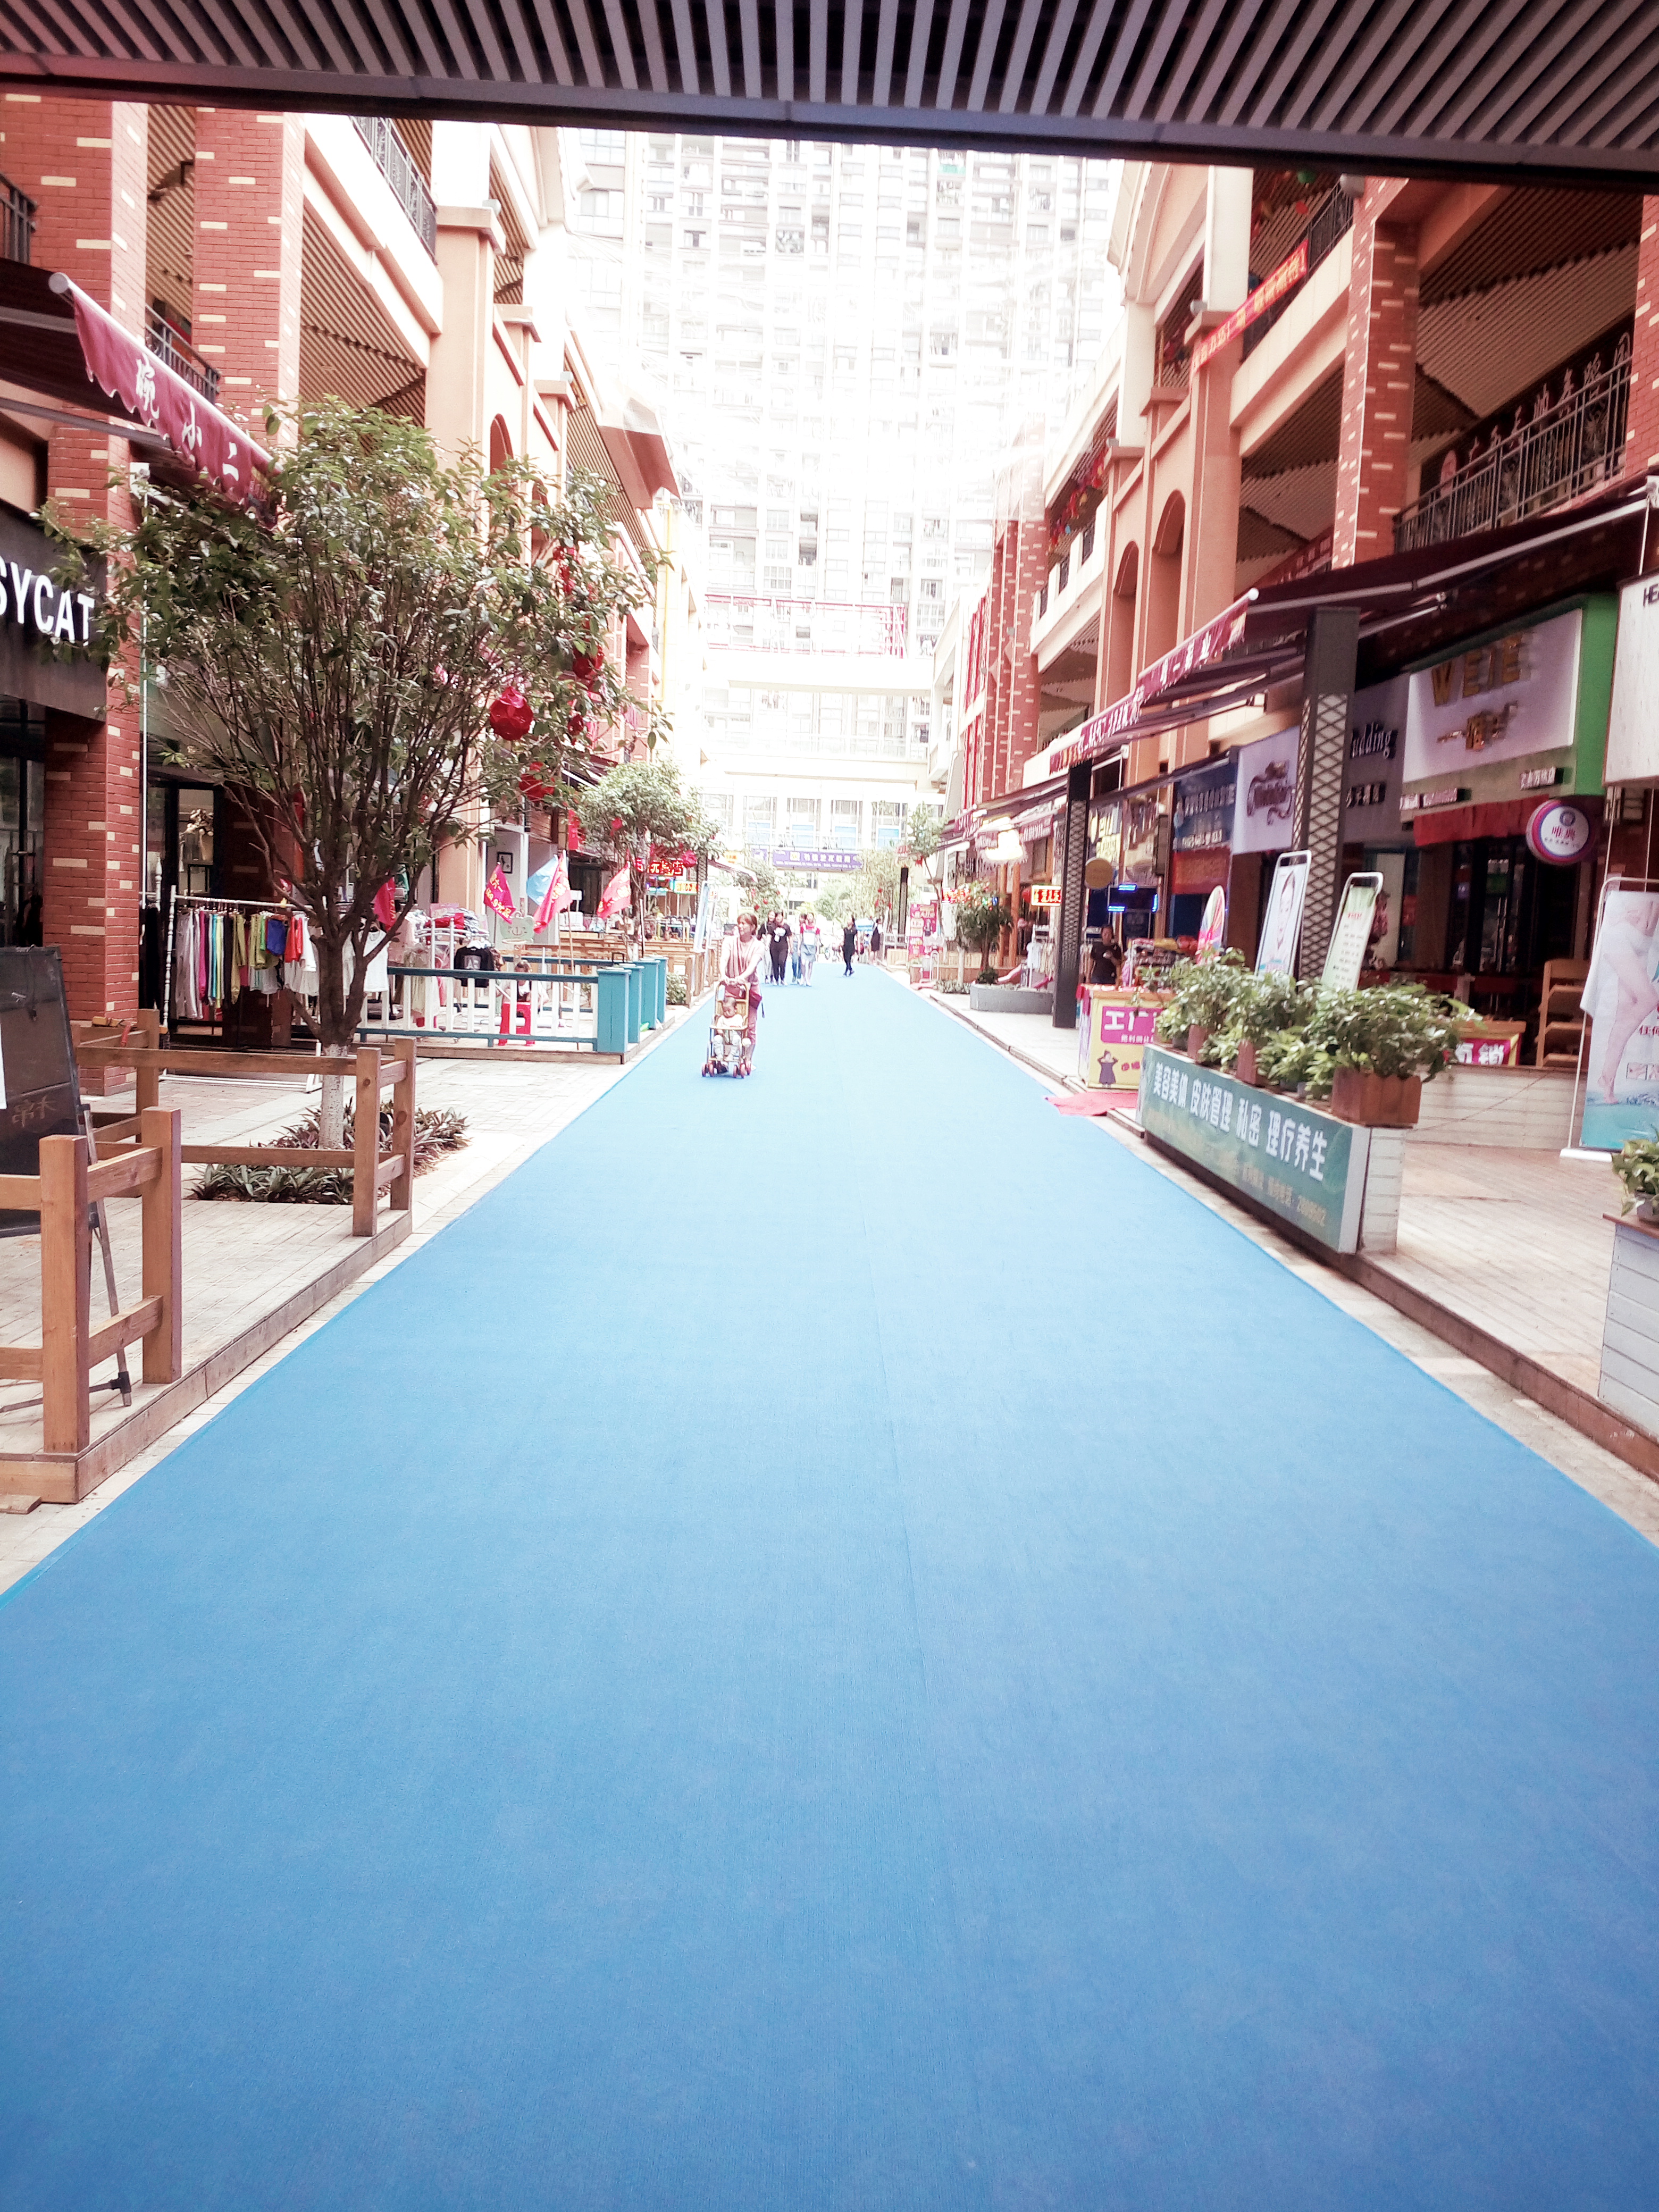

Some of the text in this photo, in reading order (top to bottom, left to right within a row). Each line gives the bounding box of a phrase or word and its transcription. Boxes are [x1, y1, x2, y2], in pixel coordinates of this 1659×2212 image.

[1643, 584, 1659, 608] HE
[1104, 1010, 1158, 1032] 工厂
[1153, 1062, 1189, 1108] 美容美体
[1190, 1078, 1233, 1133] 皮肤管理
[1236, 1097, 1262, 1147] 私密
[1265, 1110, 1327, 1182] 理疗养生
